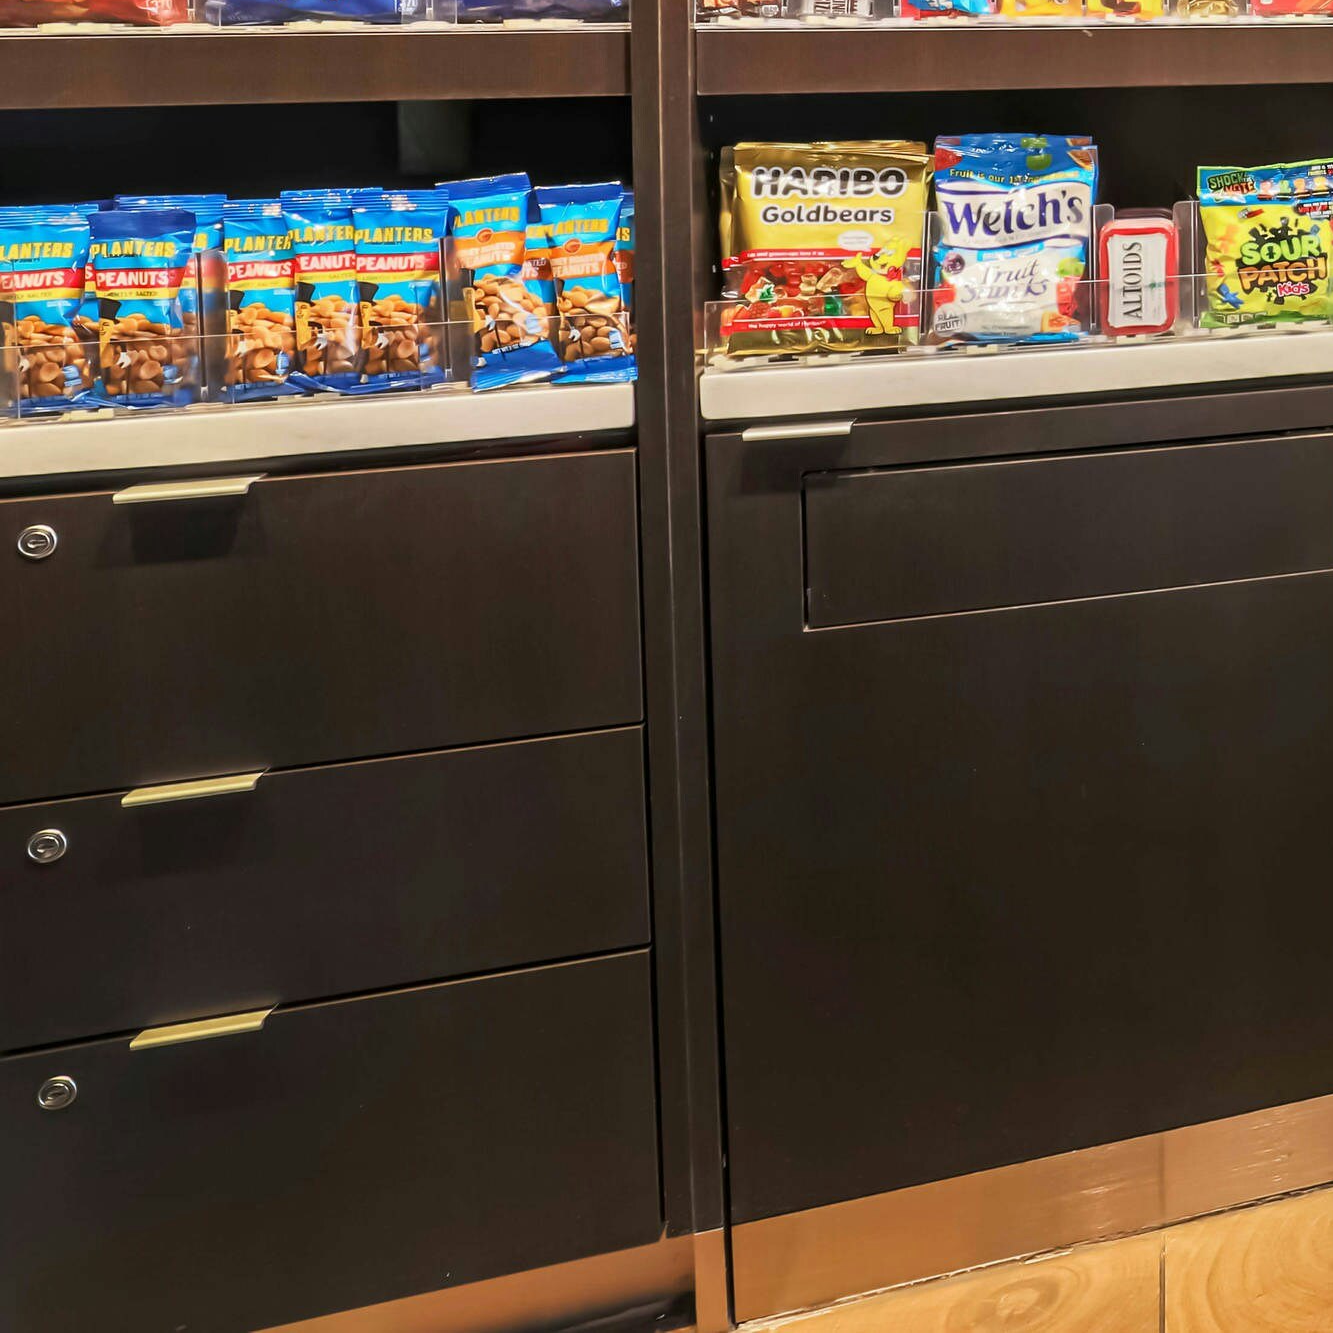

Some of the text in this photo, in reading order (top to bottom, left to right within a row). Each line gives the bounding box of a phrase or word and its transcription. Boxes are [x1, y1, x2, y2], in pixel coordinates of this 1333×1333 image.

[752, 167, 906, 198] HARIBO
[950, 168, 975, 180] Fruit
[762, 204, 894, 226] Goldbears
[942, 189, 1084, 237] Welch's
[354, 227, 433, 244] PLANTERS
[91, 240, 175, 258] PLANTERS
[1240, 236, 1321, 266] SOUR
[228, 261, 292, 280] PEANUTS
[356, 255, 425, 271] PEANUTS
[97, 270, 169, 288] PEANUTS
[1122, 241, 1143, 320] ALTOIDS
[1238, 257, 1328, 291] PATCH
[1277, 281, 1310, 298] Kids
[935, 319, 961, 331] FRUIT
